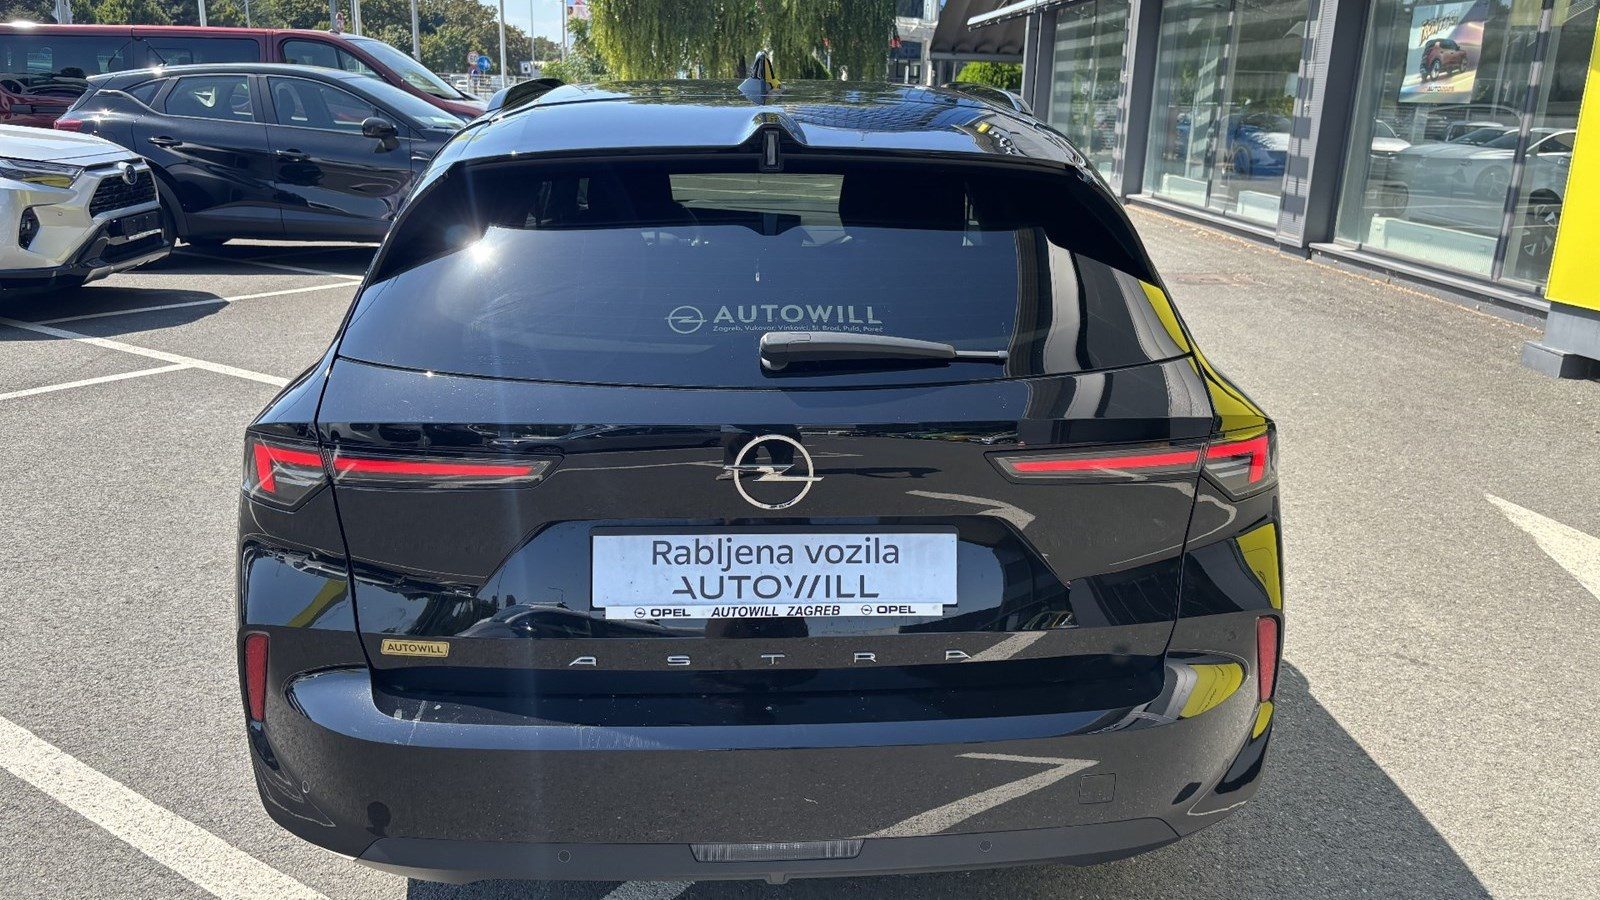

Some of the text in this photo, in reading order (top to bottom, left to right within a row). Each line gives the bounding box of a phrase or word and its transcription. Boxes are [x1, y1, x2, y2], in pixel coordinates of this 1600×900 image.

[713, 304, 883, 324] AUTOWILL
[651, 537, 900, 571] Rabljena vozila
[672, 574, 880, 600] AUTOWILL
[650, 604, 917, 618] OPEL AUTOWILL ZAGREB OPEL
[387, 643, 443, 653] AUTOWILL
[568, 650, 973, 667] ASTRA
